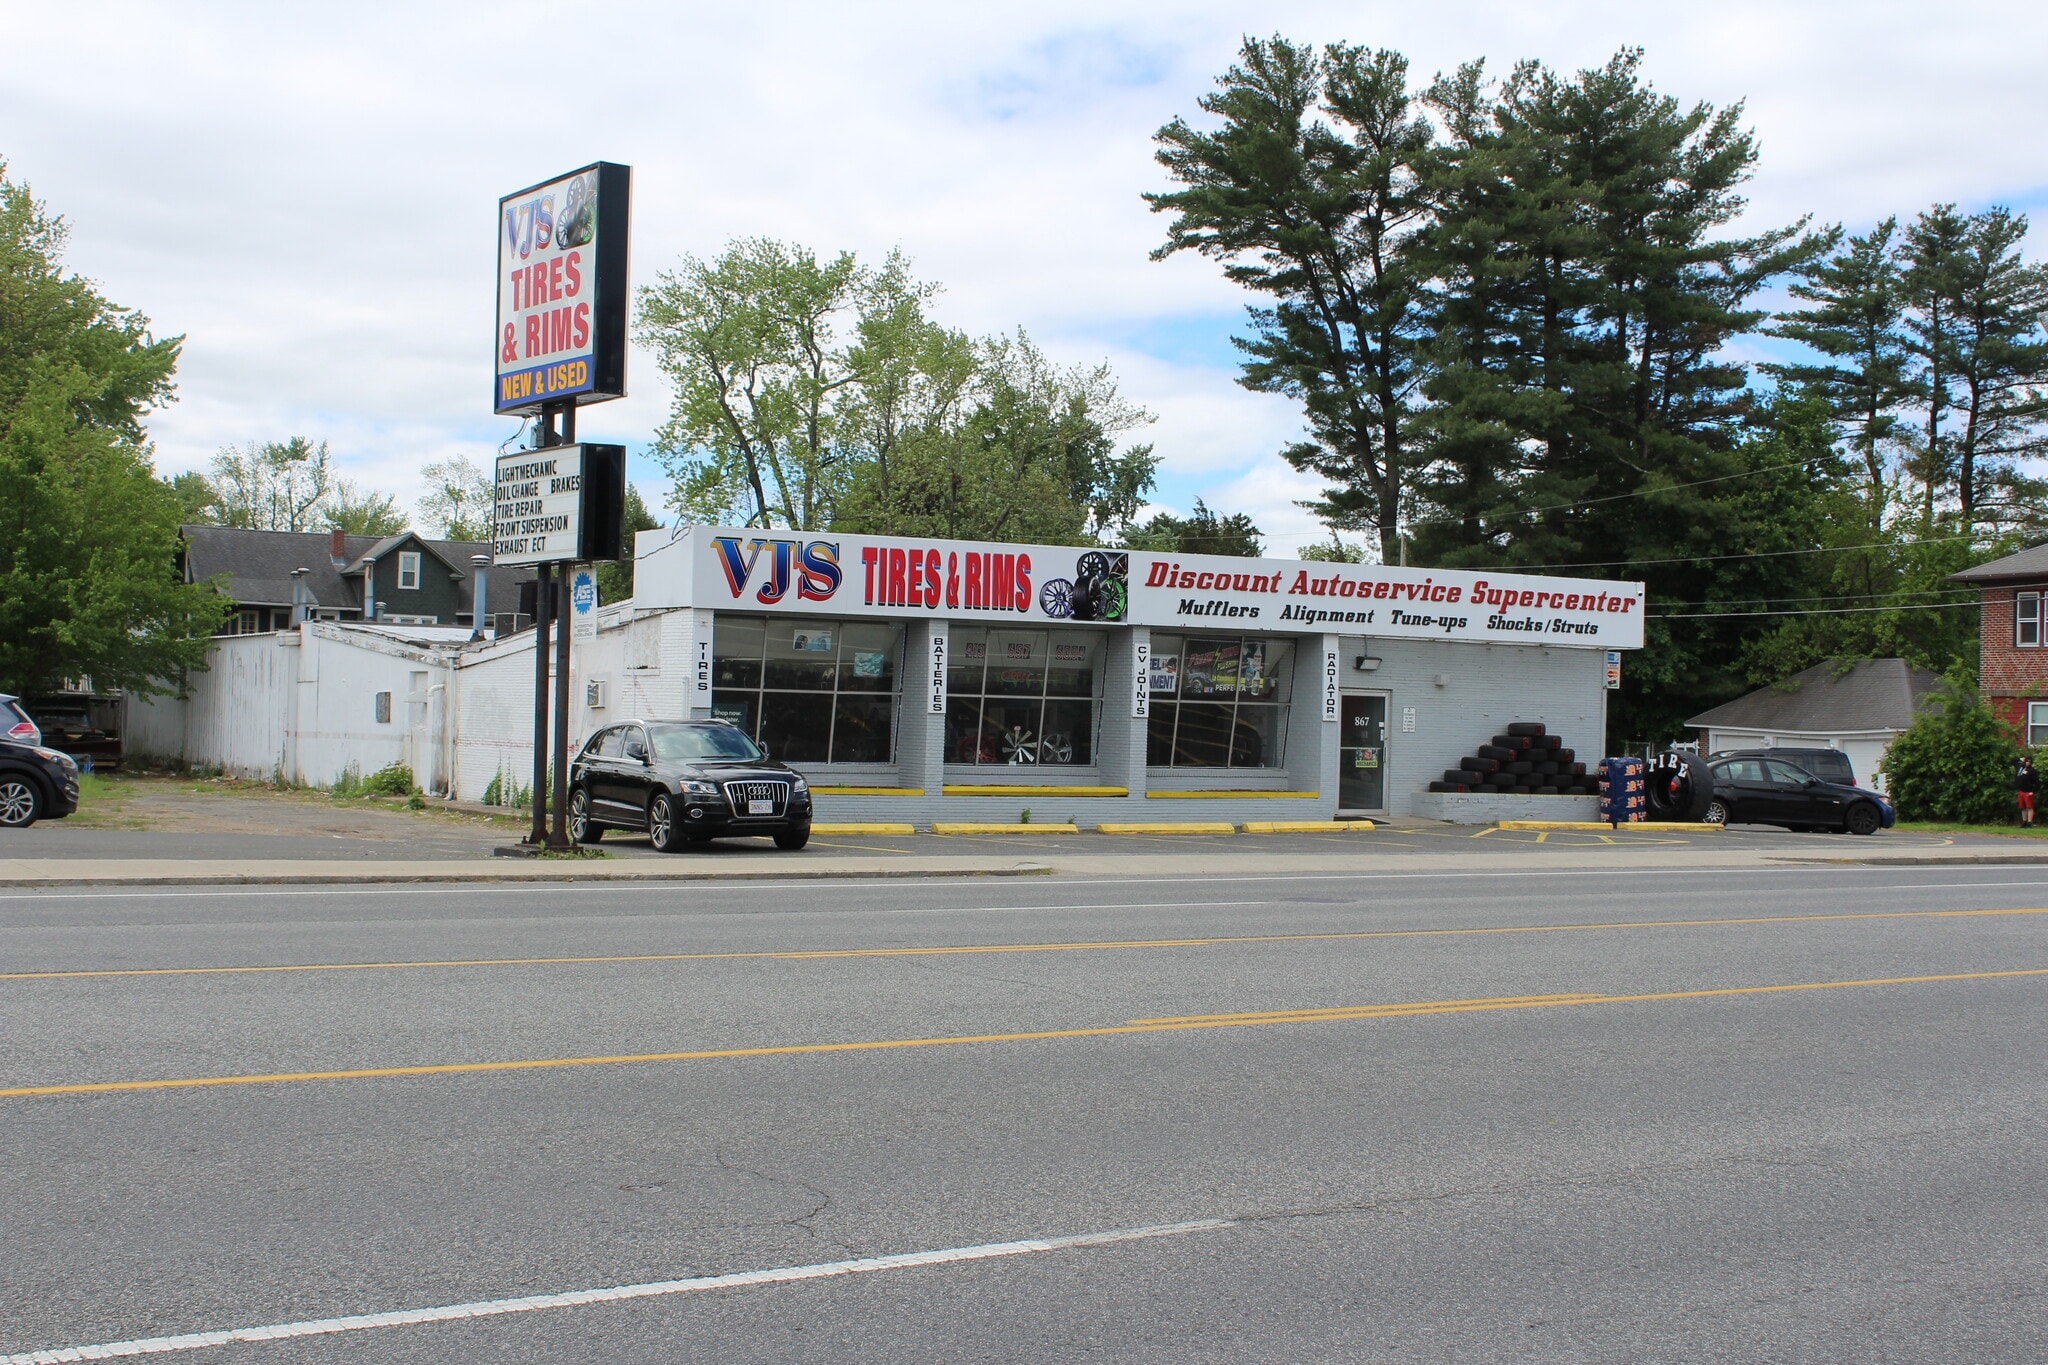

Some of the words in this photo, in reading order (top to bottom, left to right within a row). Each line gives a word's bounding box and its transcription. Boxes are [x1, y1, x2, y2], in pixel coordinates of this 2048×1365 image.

[511, 251, 581, 313] TIRES
[502, 321, 518, 364] &
[525, 302, 590, 359] RIMS
[502, 371, 532, 401] NEW
[535, 370, 544, 394] &
[547, 360, 587, 393] USED
[497, 486, 511, 501] OIL
[511, 481, 539, 499] CHANGE
[551, 475, 580, 494] BRAKES
[495, 521, 521, 537] FRONT
[521, 515, 569, 535] SUSPENSION
[497, 503, 514, 519] TIRE
[515, 500, 543, 517] REPAIR
[495, 538, 529, 555] EXHAUST
[532, 536, 546, 552] ECT
[576, 584, 591, 600] ASE
[861, 546, 942, 609] TIRES
[945, 551, 960, 609] &
[964, 552, 1032, 613] RIMS
[1145, 561, 1283, 594] Discount
[1288, 570, 1462, 603] Autoservice
[1470, 580, 1636, 614] Supercenter
[1177, 598, 1260, 618] Mufflers
[1279, 604, 1375, 625] Alignment
[1391, 609, 1468, 633] Tune-ups
[697, 642, 708, 691] TIRES
[1138, 646, 1147, 663] CV
[933, 637, 944, 712] BATTERIES
[1136, 668, 1146, 715] JOINTS
[1326, 652, 1336, 714] RADIATOR
[1354, 716, 1370, 726] 867
[1648, 754, 1689, 778] TIRE
